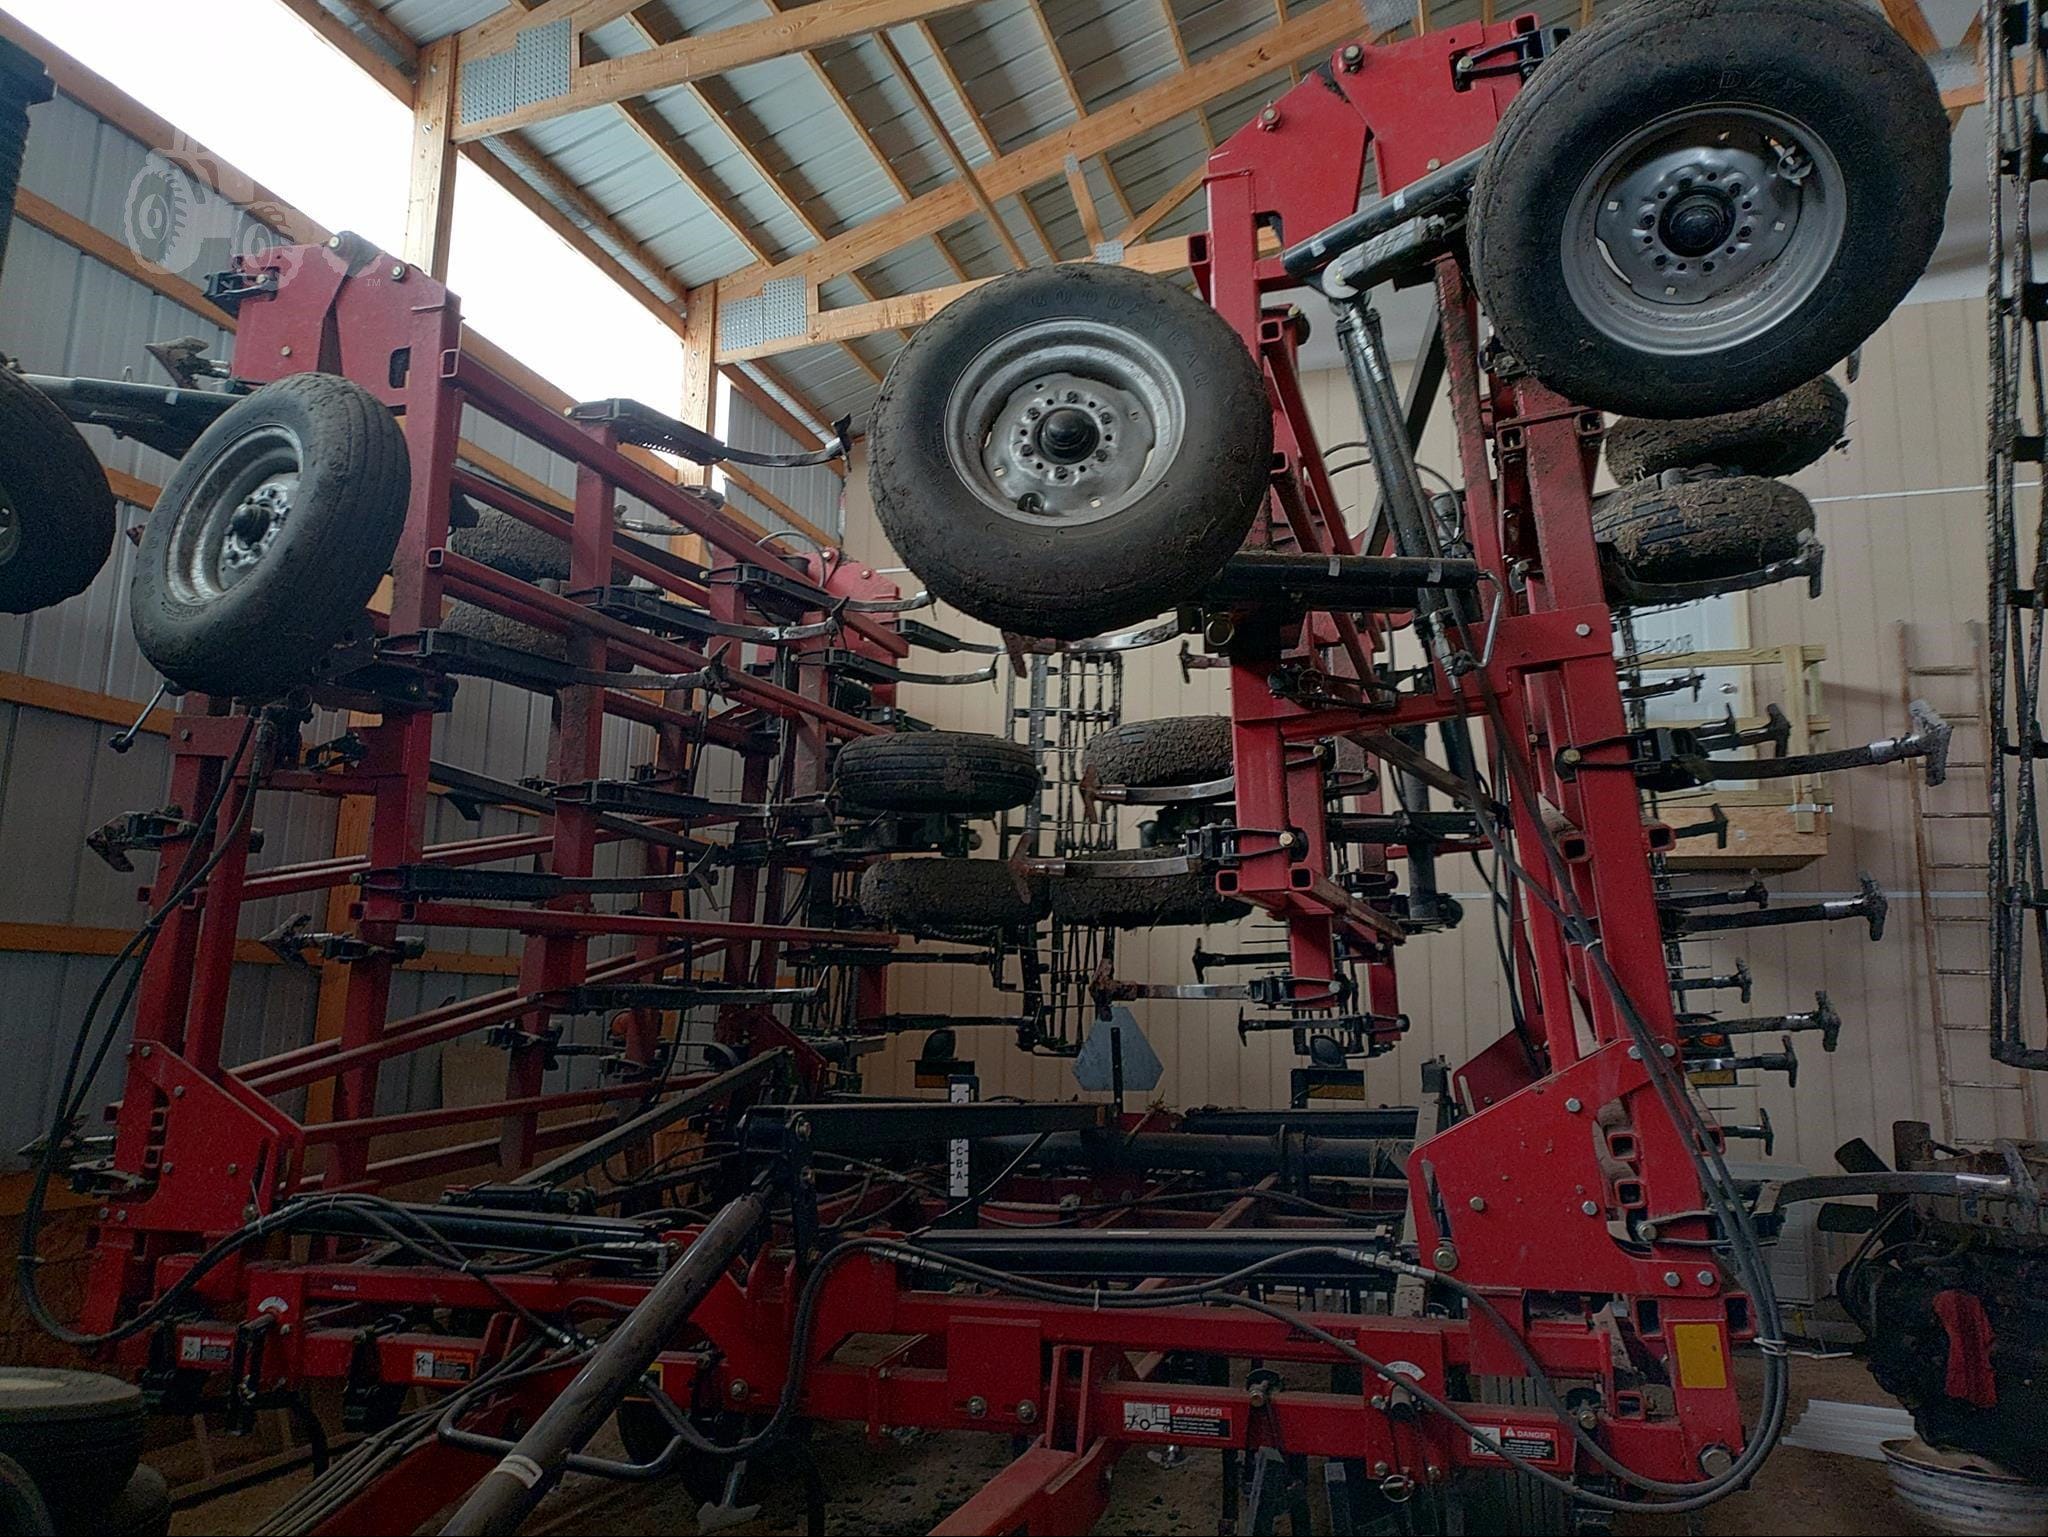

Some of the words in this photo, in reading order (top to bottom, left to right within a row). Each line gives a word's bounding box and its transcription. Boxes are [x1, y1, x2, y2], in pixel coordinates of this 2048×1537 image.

[956, 1146, 963, 1156] C
[956, 1159, 963, 1168] B
[956, 1171, 963, 1180] A
[1184, 1406, 1222, 1417] DANGER
[1516, 1430, 1551, 1439] DANGER
